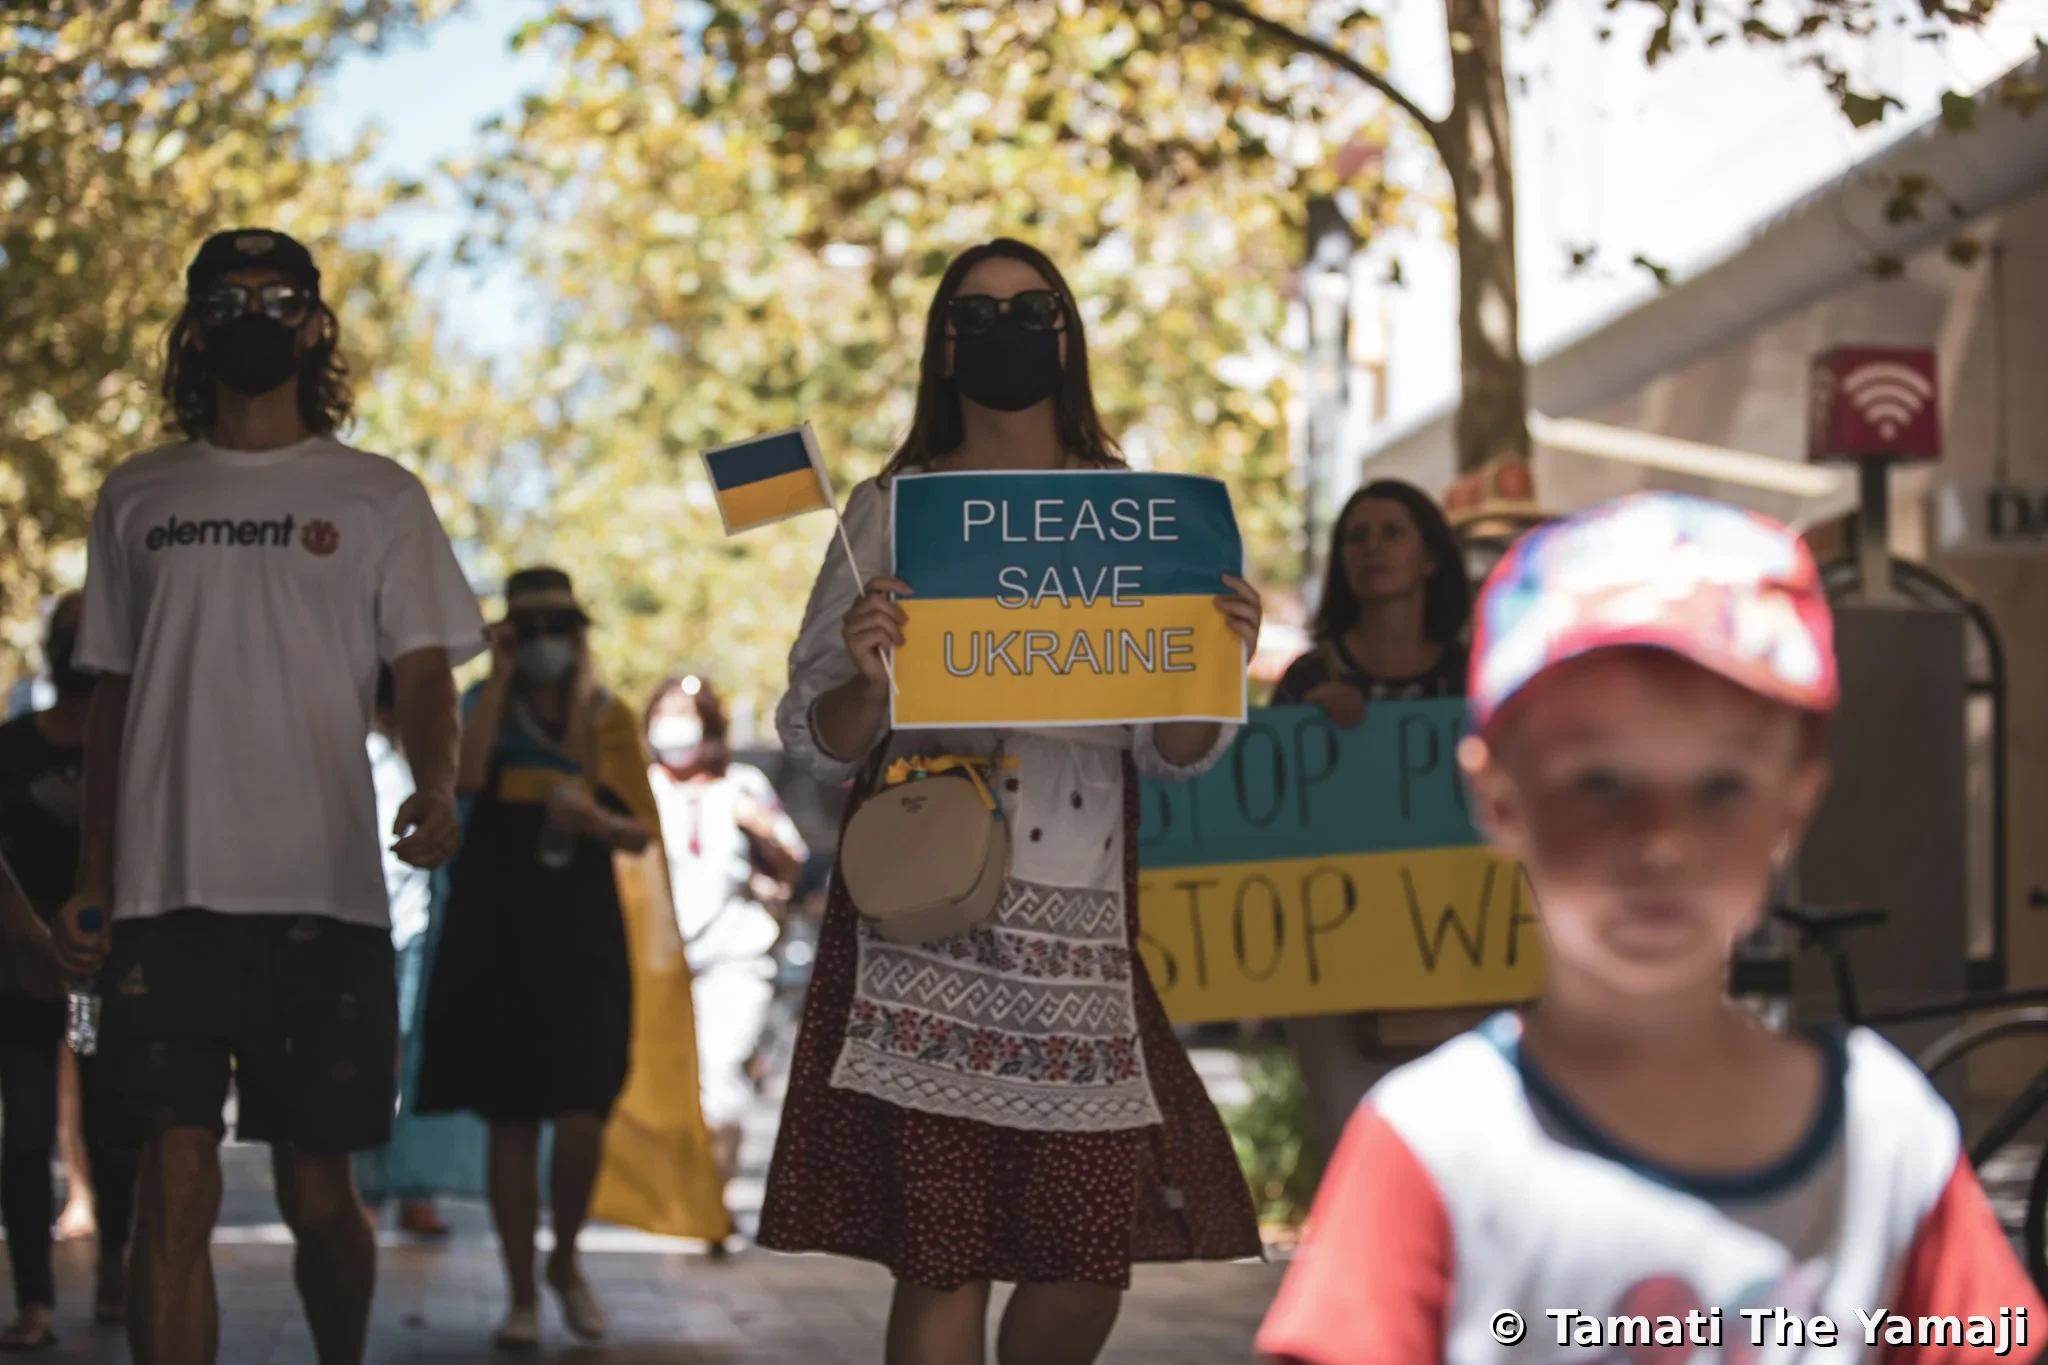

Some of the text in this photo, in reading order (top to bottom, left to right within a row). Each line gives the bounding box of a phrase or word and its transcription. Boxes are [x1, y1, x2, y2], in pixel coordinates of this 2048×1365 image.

[145, 513, 295, 551] element
[962, 498, 1179, 543] PLEASE
[996, 565, 1145, 610] SAVE
[944, 627, 1196, 677] UKRAINE
